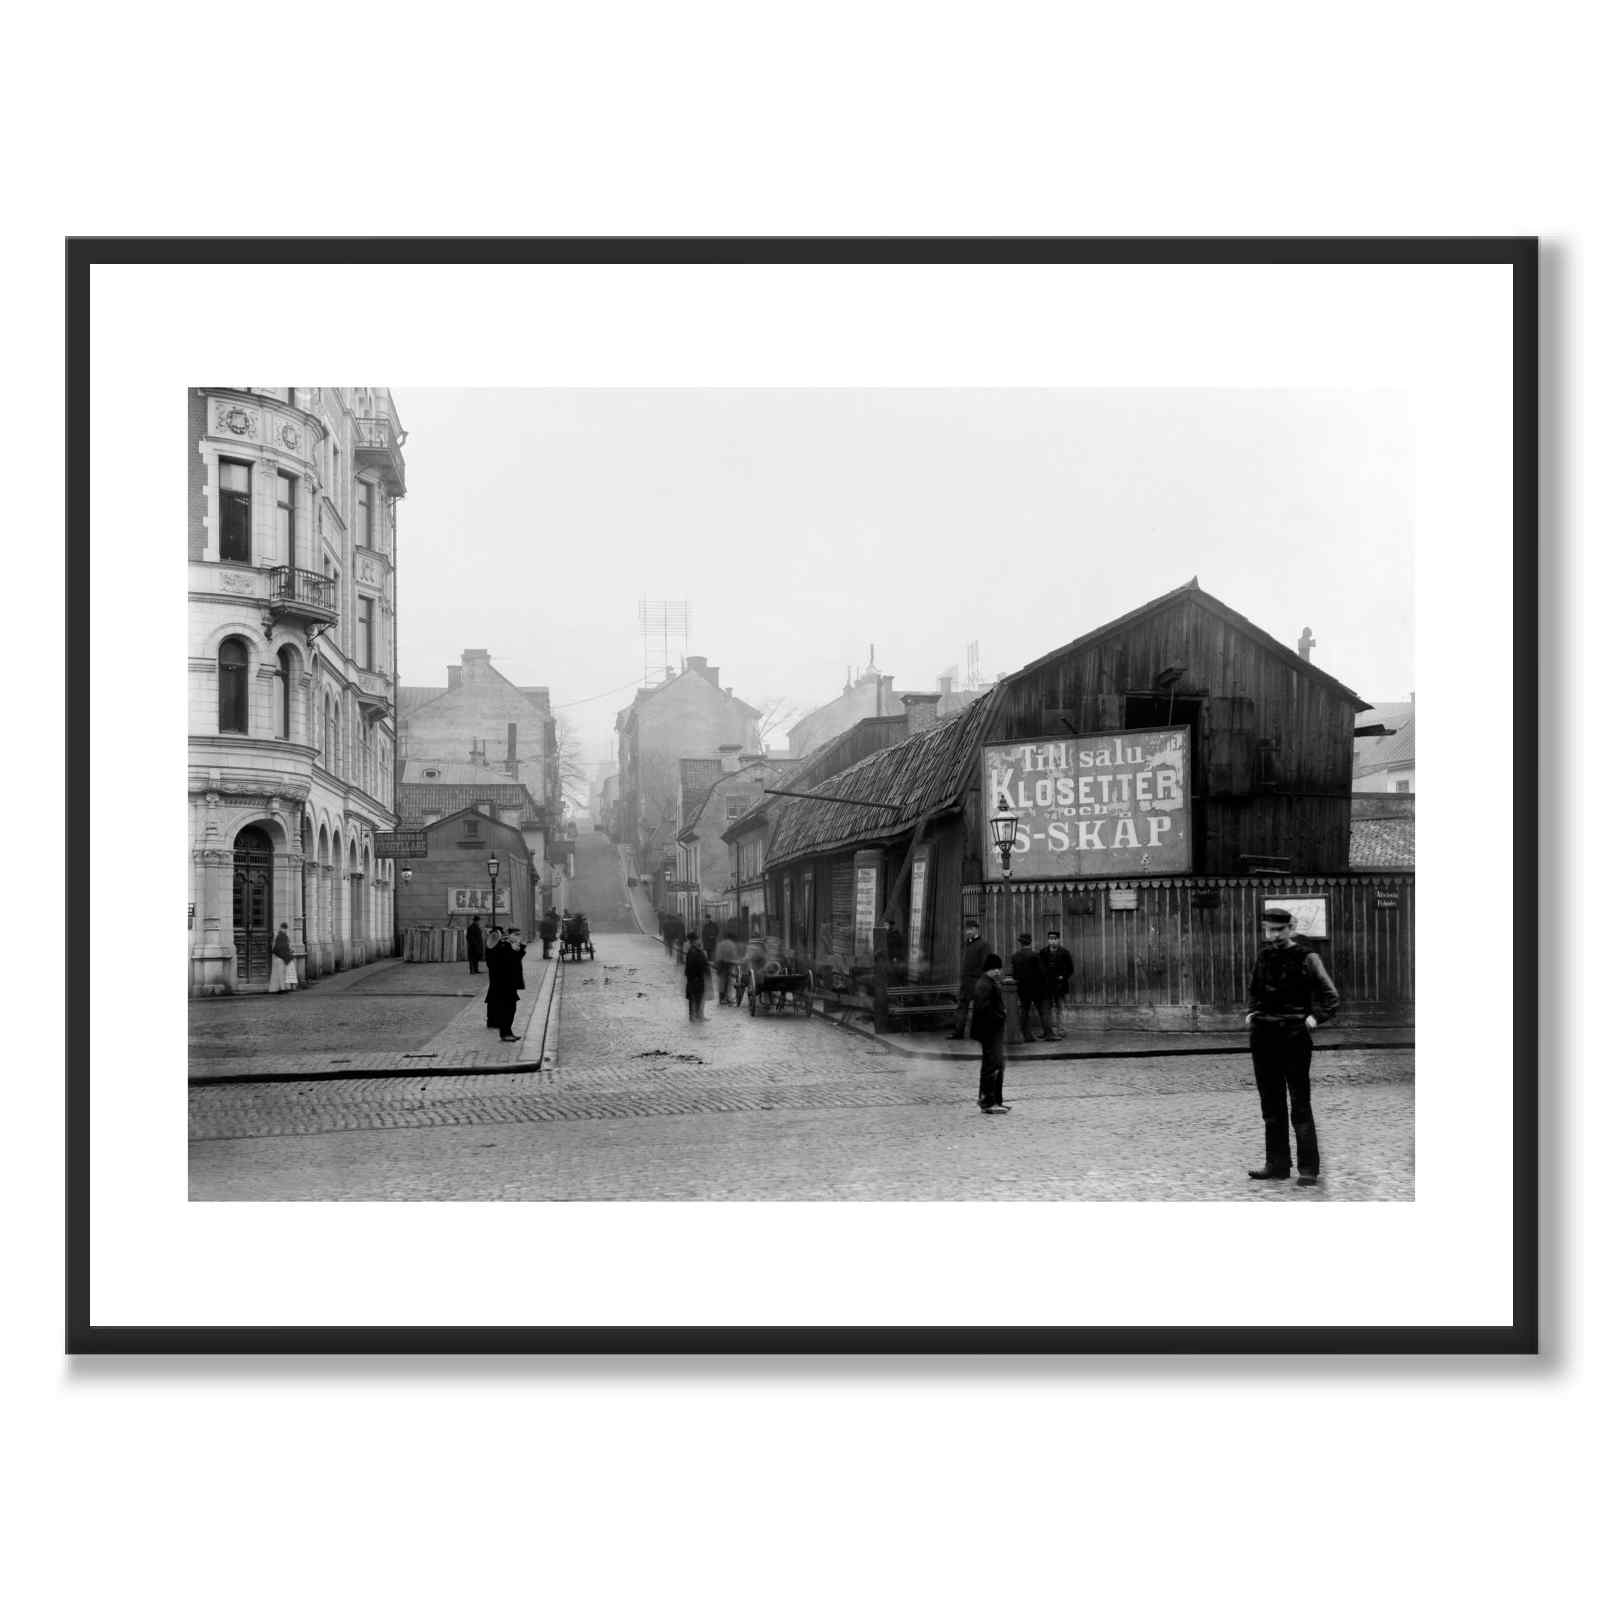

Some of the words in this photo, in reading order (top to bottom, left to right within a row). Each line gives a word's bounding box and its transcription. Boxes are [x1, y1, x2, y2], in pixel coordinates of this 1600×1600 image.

[1018, 743, 1069, 771] Till
[991, 768, 1178, 809] KLOSETTER
[1063, 798, 1108, 817] och
[992, 811, 1172, 854] S-SKÅP
